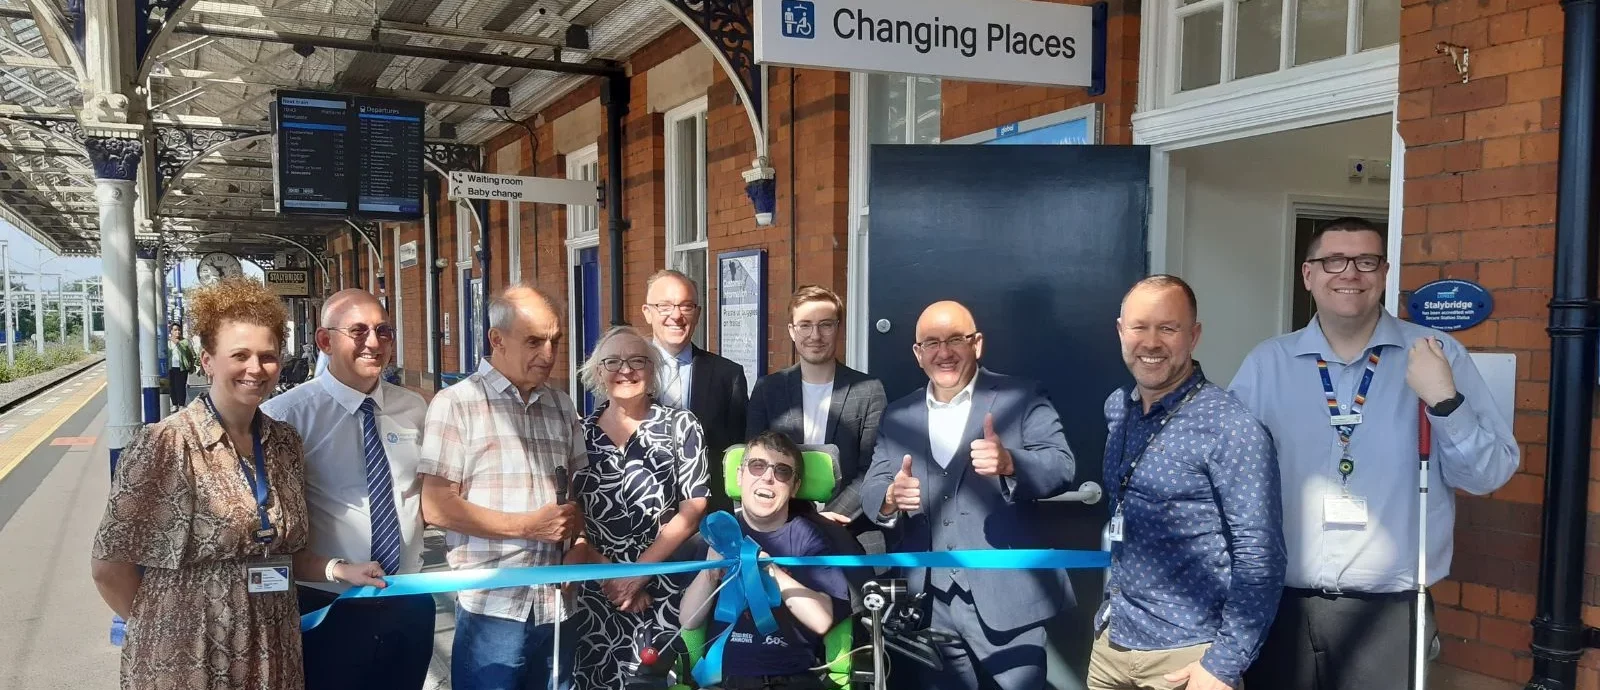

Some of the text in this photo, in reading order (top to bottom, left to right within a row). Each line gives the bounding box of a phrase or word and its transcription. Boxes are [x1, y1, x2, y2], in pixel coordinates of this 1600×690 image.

[833, 8, 1076, 59] Changing Places
[367, 106, 400, 115] Departures
[467, 174, 523, 186] Waiting room
[468, 188, 523, 199] Baby change
[270, 273, 304, 281] STALYBRIDGE
[1424, 300, 1473, 310] Stalybridge
